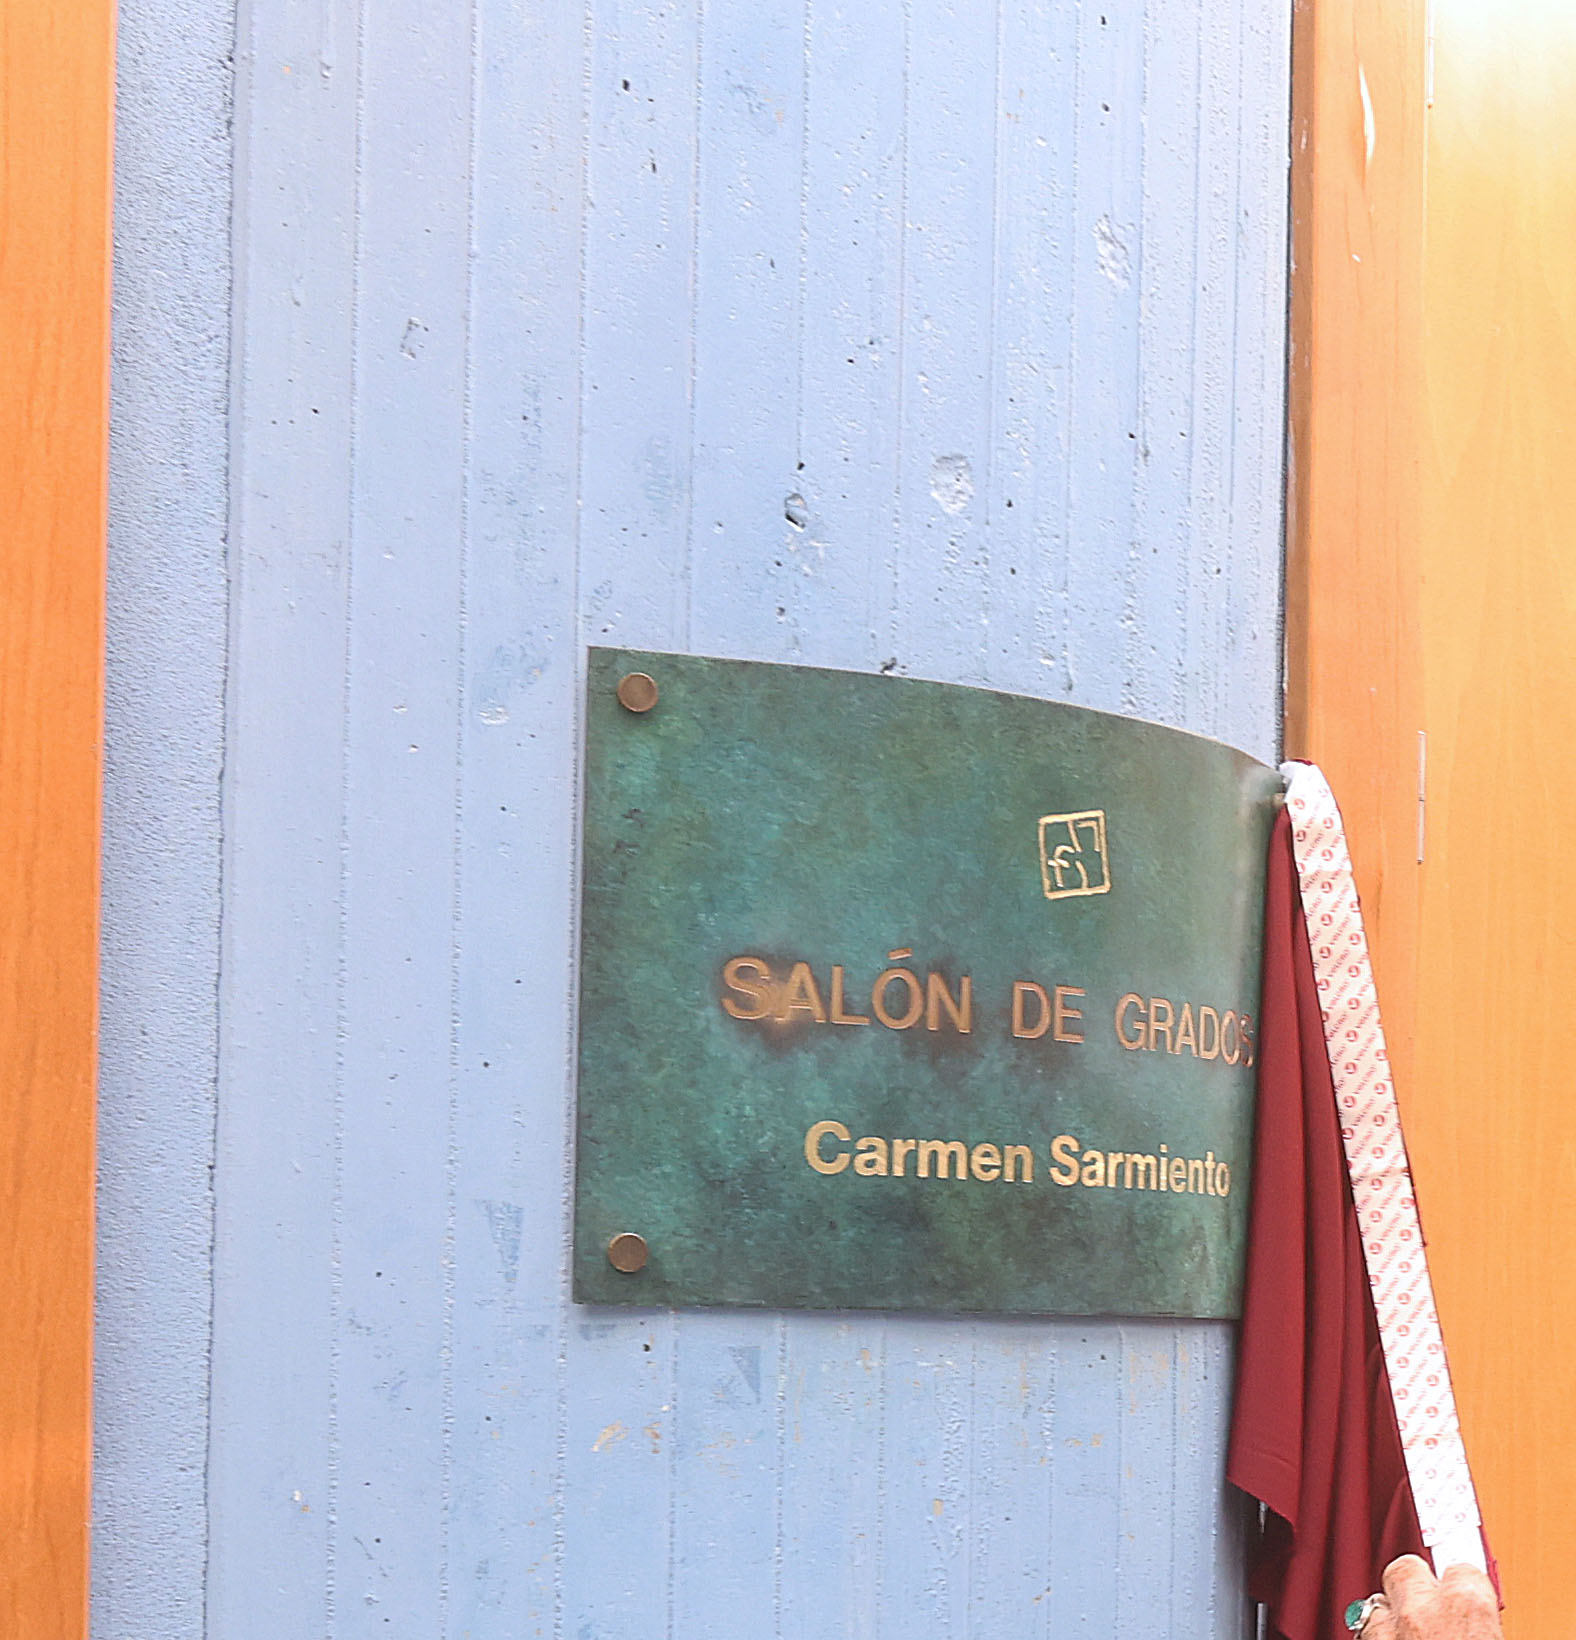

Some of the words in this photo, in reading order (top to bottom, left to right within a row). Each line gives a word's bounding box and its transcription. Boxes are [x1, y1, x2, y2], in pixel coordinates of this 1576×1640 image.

[720, 947, 973, 1035] SALÓN
[1011, 981, 1086, 1044] DE
[1114, 992, 1255, 1068] GRADOS
[803, 1120, 1034, 1184] Carmen
[1049, 1136, 1230, 1198] Sarmiento
